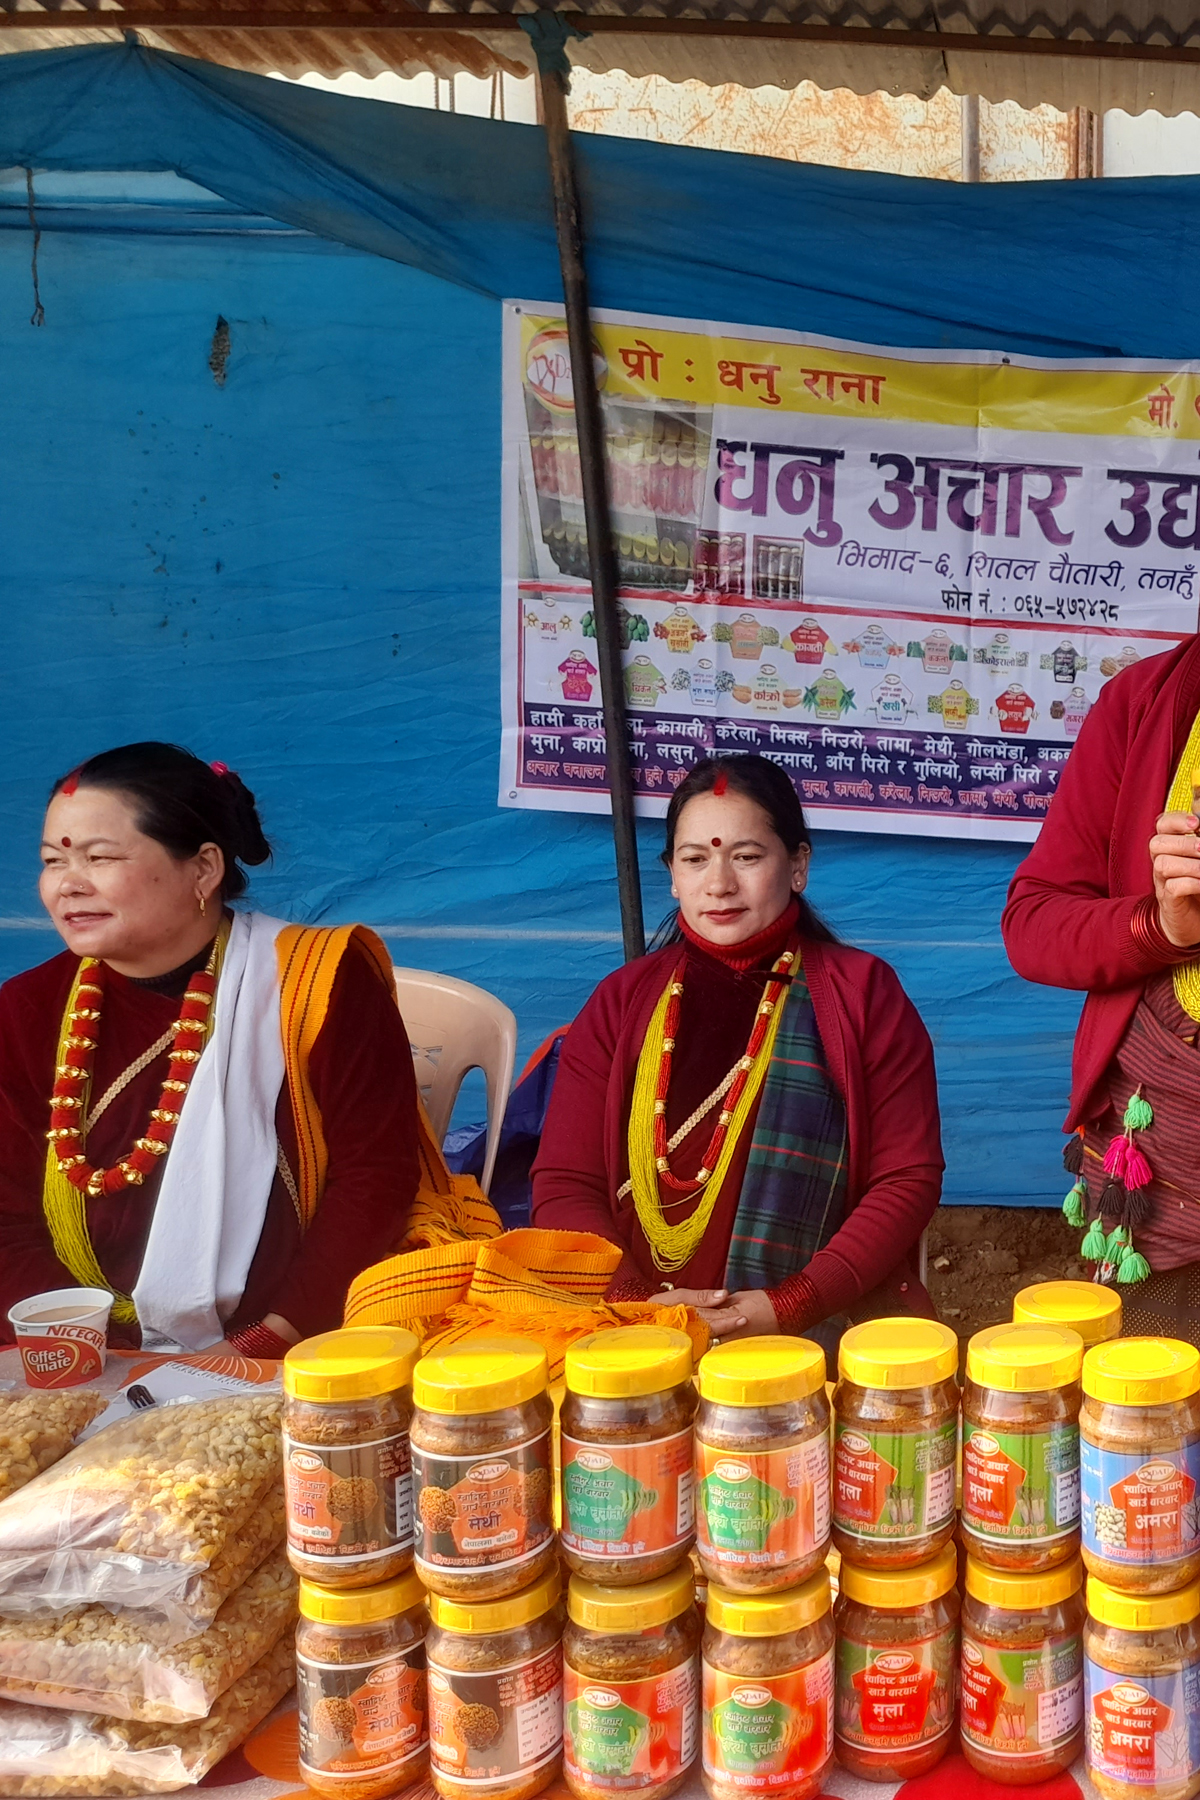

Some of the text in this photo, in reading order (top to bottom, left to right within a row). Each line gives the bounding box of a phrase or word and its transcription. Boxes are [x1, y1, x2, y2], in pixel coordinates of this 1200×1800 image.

[620, 340, 663, 383] प्रो
[718, 360, 781, 405] धनु
[801, 368, 886, 405] राना
[1148, 383, 1178, 428] मो.
[714, 438, 845, 548] धनु
[868, 450, 1083, 547] अचार
[966, 549, 1036, 583] शितल
[1047, 552, 1126, 592] चौतारी,
[941, 583, 973, 613] फोन
[795, 642, 823, 654] कागती
[882, 700, 900, 711] खसी
[530, 707, 565, 728] हामी
[655, 718, 708, 742] कागती,
[716, 721, 761, 746] करेला,
[770, 724, 813, 749] मिक्स,
[876, 735, 915, 756] तामा,
[924, 735, 957, 759] मेथी,
[527, 760, 559, 777] अचार
[656, 743, 698, 764] लसुन,
[861, 755, 890, 774] पिरो
[897, 760, 907, 775] र
[913, 760, 963, 782] गुलियो,
[970, 763, 1006, 782] लप्सी
[1013, 764, 1041, 784] पिरो
[1048, 770, 1058, 784] र
[27, 1349, 65, 1366] Coffee
[36, 1357, 71, 1373] mate
[839, 1479, 862, 1501] मुला
[969, 1481, 993, 1503] मुला
[1160, 1480, 1183, 1492] अचार
[468, 1510, 501, 1531] मेथी
[1135, 1510, 1178, 1530] अमरा
[369, 1710, 401, 1732] मेथी
[872, 1703, 905, 1722] मुला
[1133, 1707, 1158, 1716] अचार
[1110, 1730, 1152, 1753] अमरा
